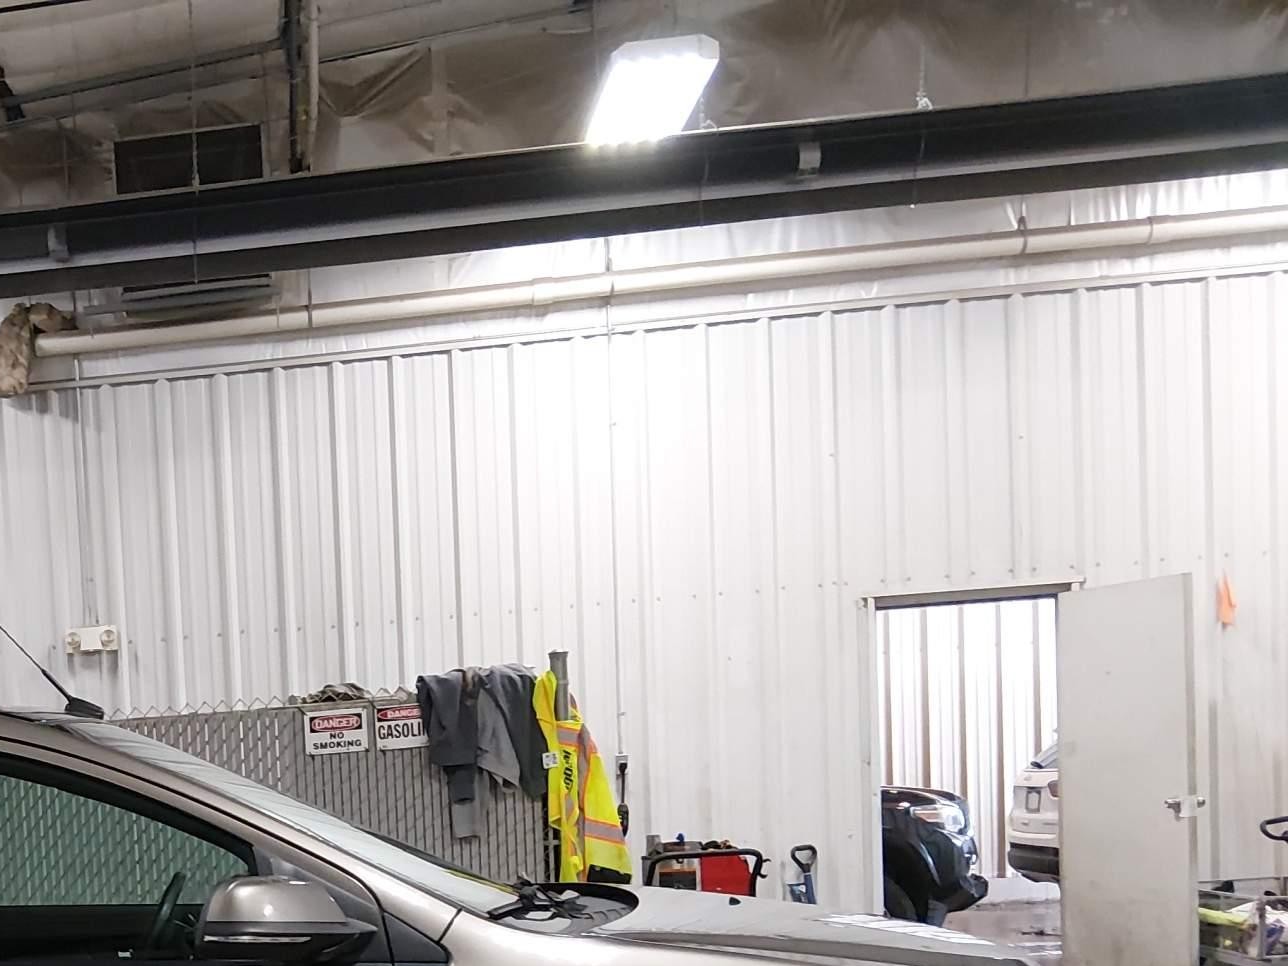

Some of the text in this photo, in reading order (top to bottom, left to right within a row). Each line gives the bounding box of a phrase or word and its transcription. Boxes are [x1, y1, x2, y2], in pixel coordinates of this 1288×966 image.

[314, 716, 360, 729] DANGER
[329, 731, 344, 739] NO
[313, 739, 362, 750] SMOKING
